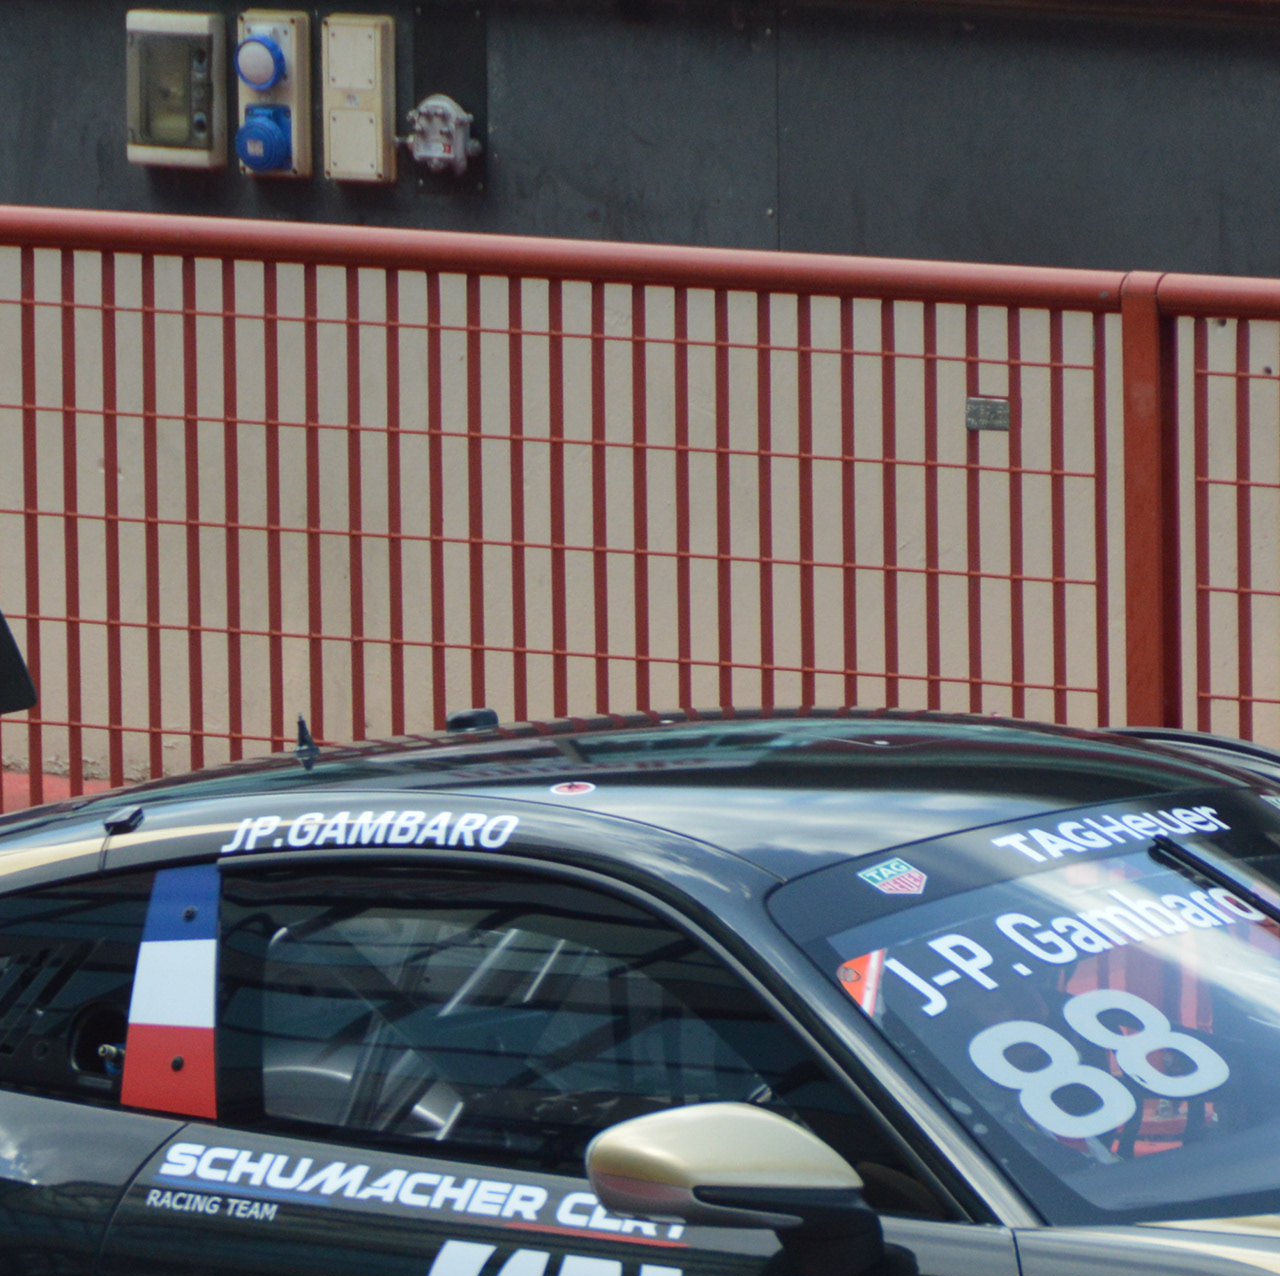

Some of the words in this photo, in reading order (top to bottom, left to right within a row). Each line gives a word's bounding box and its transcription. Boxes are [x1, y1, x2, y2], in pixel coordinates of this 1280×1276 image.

[221, 810, 519, 853] JP.GAMBARO
[865, 860, 908, 882] TAG
[994, 888, 1267, 965] Gambaro
[968, 987, 1230, 1139] 88
[145, 1188, 221, 1215] RACING
[226, 1197, 278, 1222] TEAM
[158, 1142, 548, 1222] SCHUMACHER
